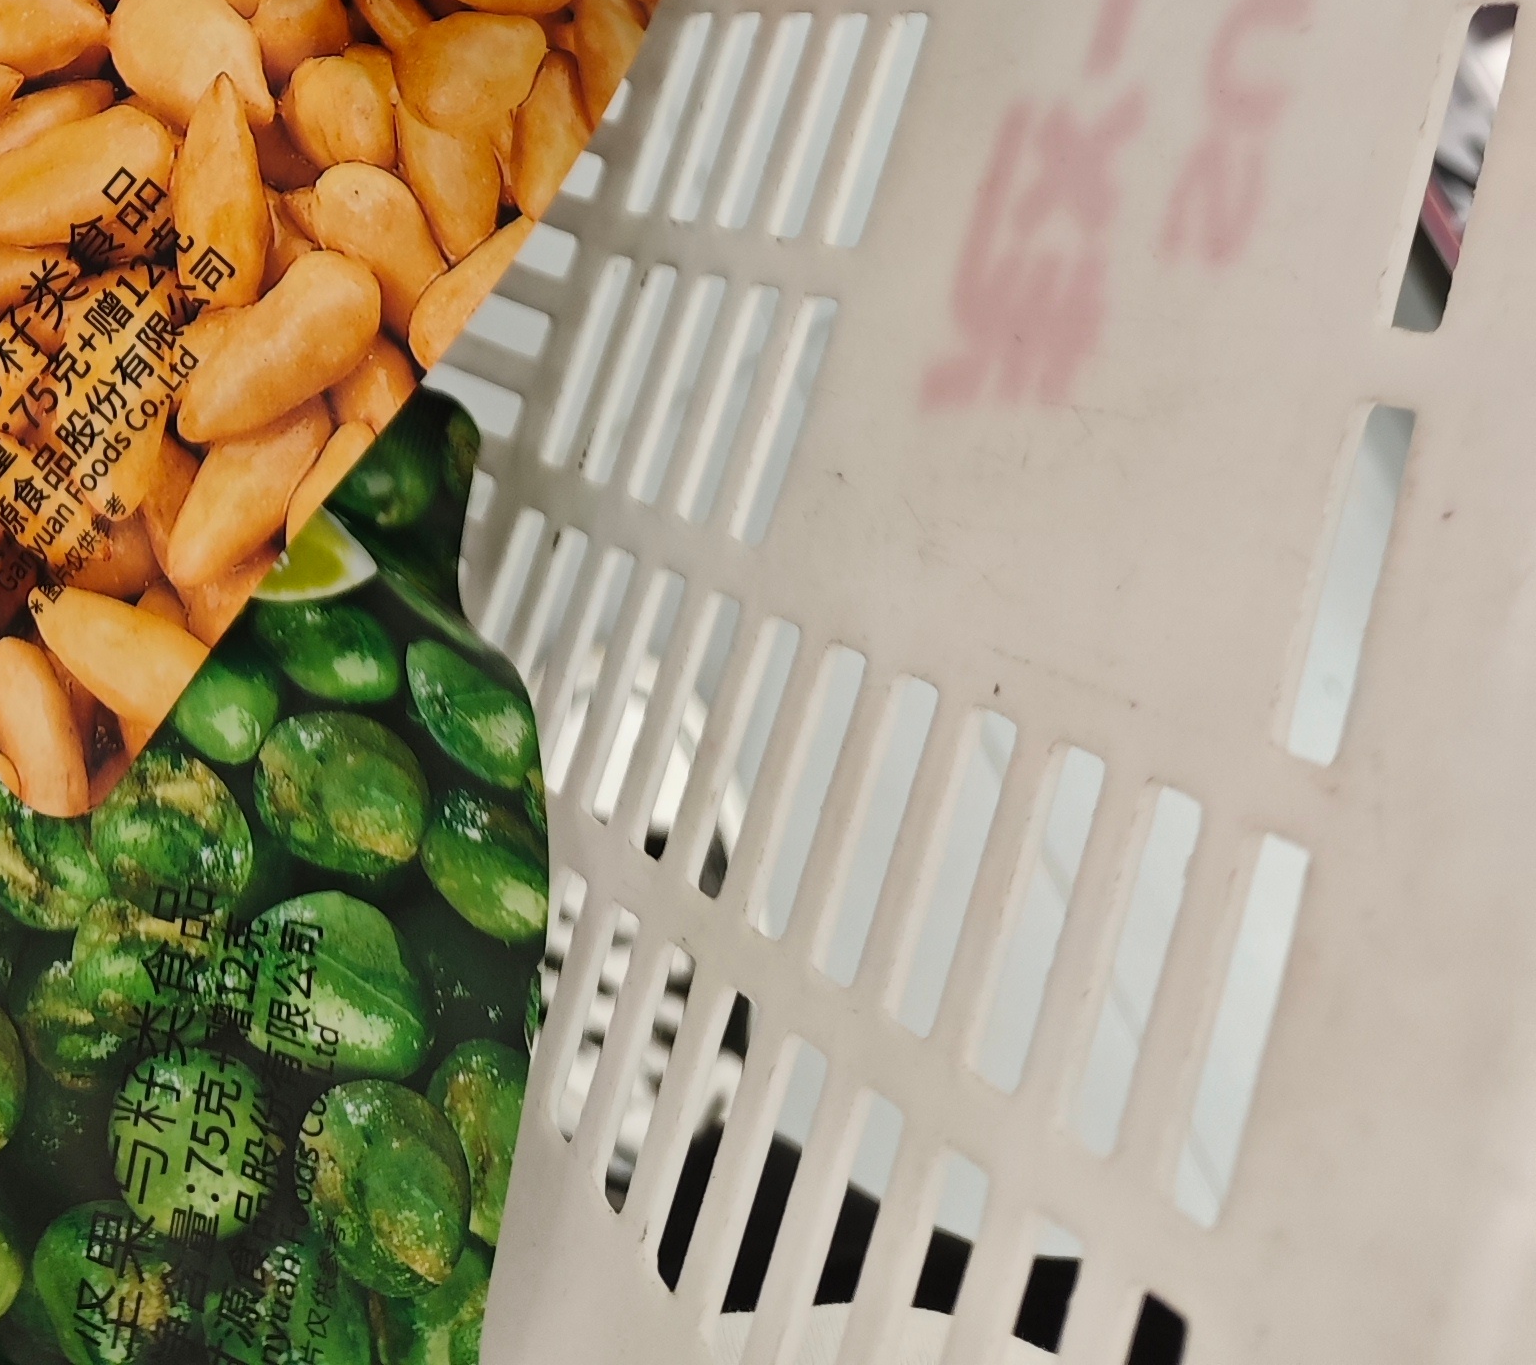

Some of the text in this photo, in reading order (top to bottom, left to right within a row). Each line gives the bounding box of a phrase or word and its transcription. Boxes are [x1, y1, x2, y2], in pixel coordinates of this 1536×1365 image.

[64, 432, 132, 500] Foods
[74, 885, 215, 1361] 坚果与籽类食品
